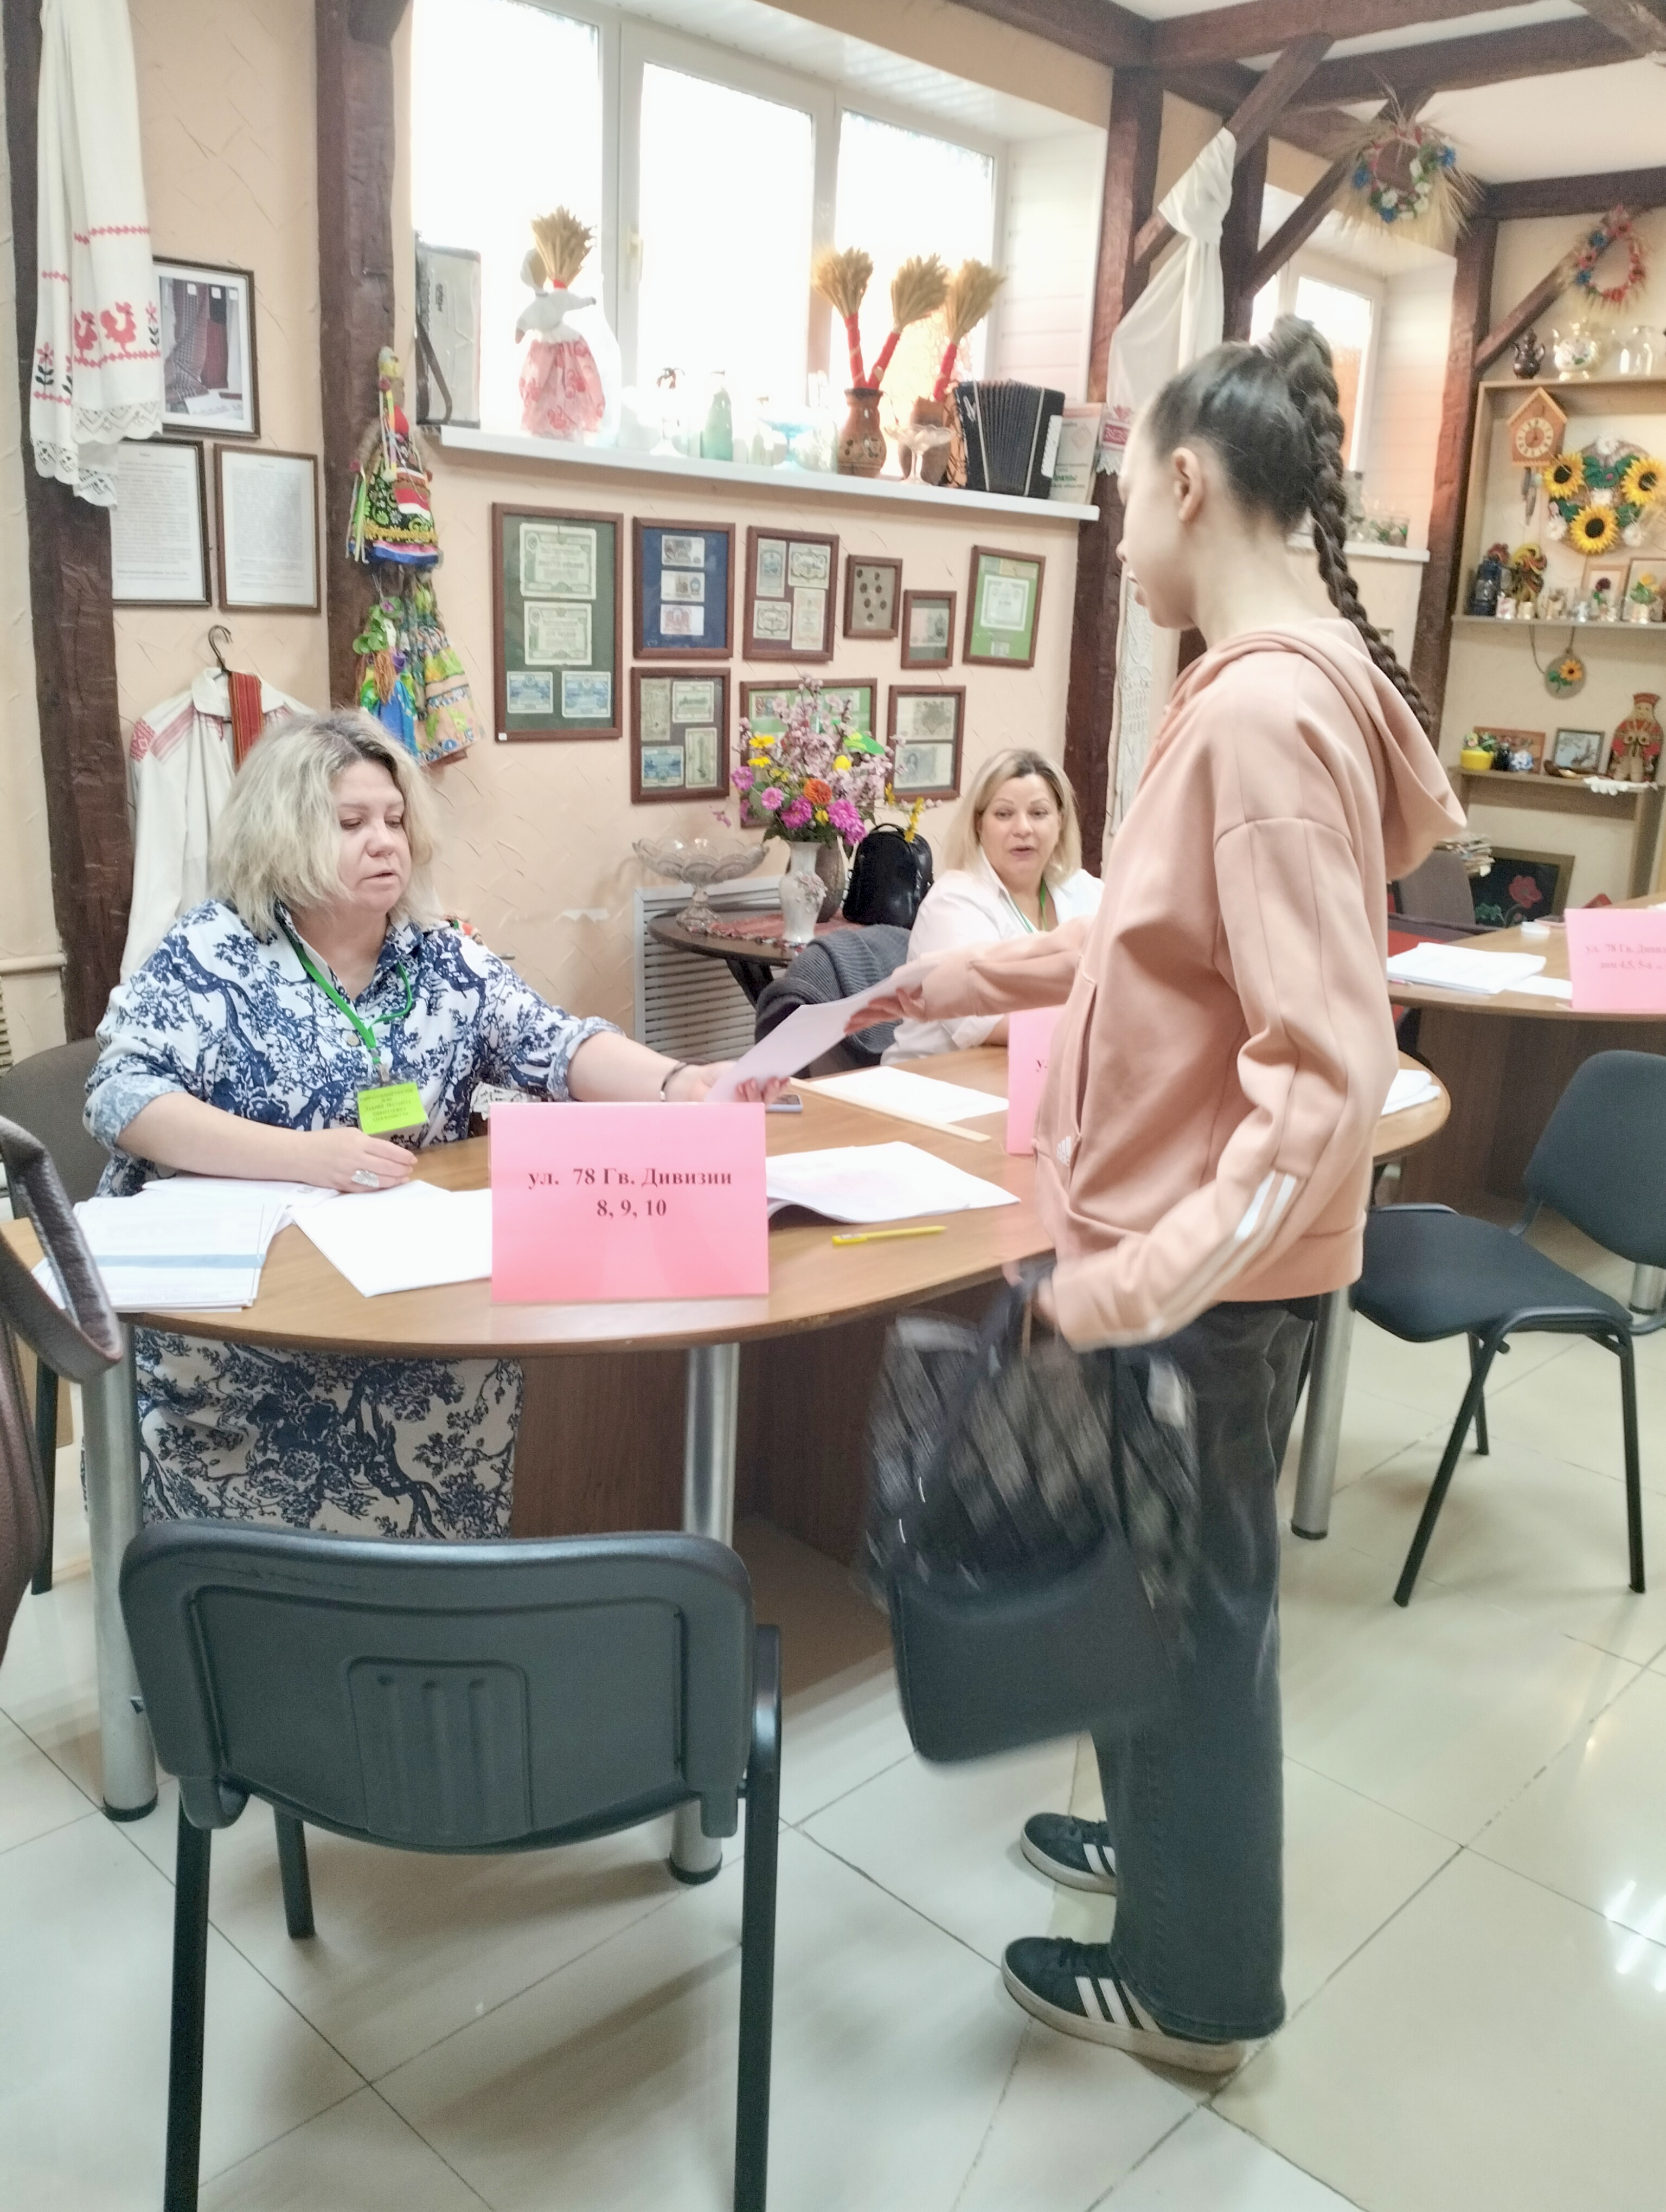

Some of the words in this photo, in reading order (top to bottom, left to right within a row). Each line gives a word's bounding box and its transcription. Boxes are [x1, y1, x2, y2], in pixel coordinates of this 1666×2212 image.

[1605, 943, 1617, 953] 78
[528, 1172, 559, 1190] ул.
[573, 1167, 596, 1185] 78
[603, 1167, 635, 1185] Гв.
[641, 1167, 732, 1188] Дивизии
[597, 1199, 614, 1219] 8,
[620, 1199, 638, 1219] 9,
[646, 1199, 667, 1217] 10
